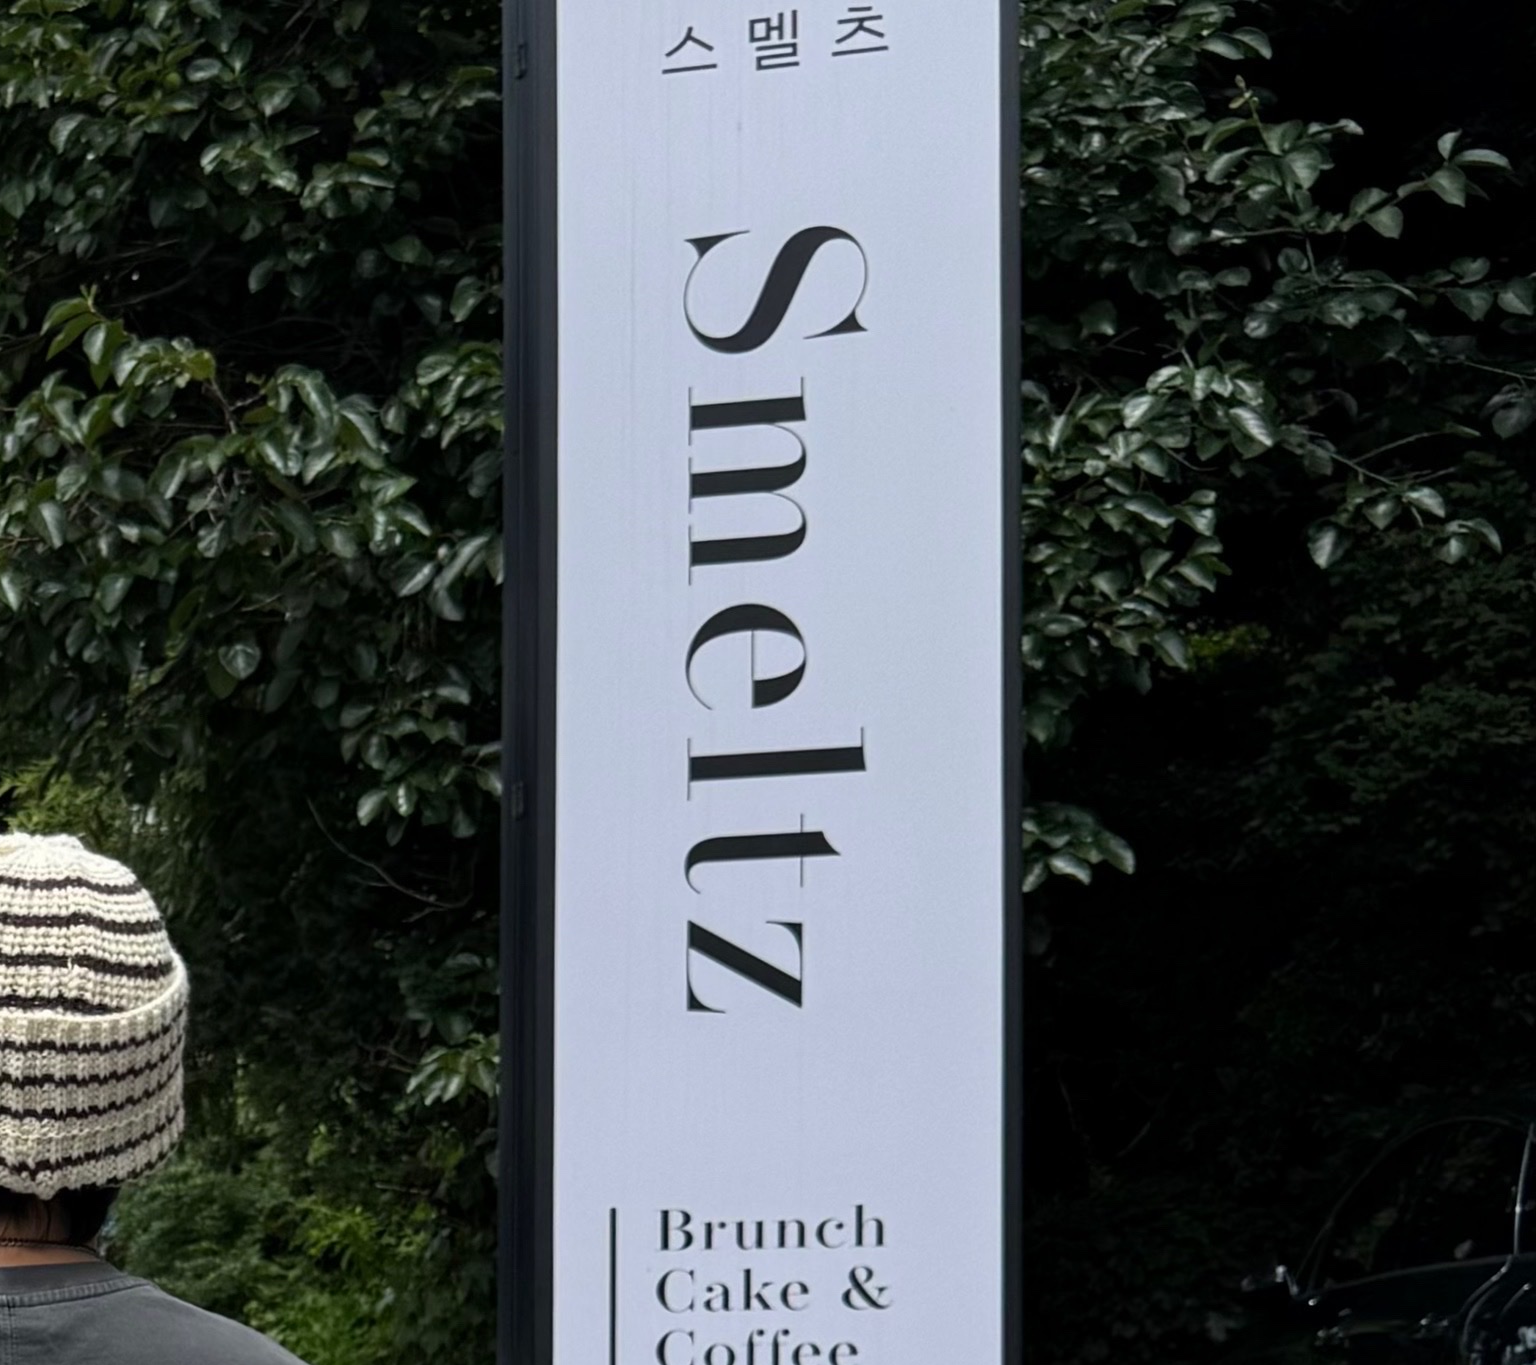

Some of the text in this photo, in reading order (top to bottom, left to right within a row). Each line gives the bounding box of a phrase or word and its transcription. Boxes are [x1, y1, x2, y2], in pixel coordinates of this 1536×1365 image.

[661, 5, 889, 75] 스멜츠
[683, 225, 868, 1014] Smeltz
[657, 1203, 886, 1252] Brunch
[655, 1265, 891, 1313] Cake &
